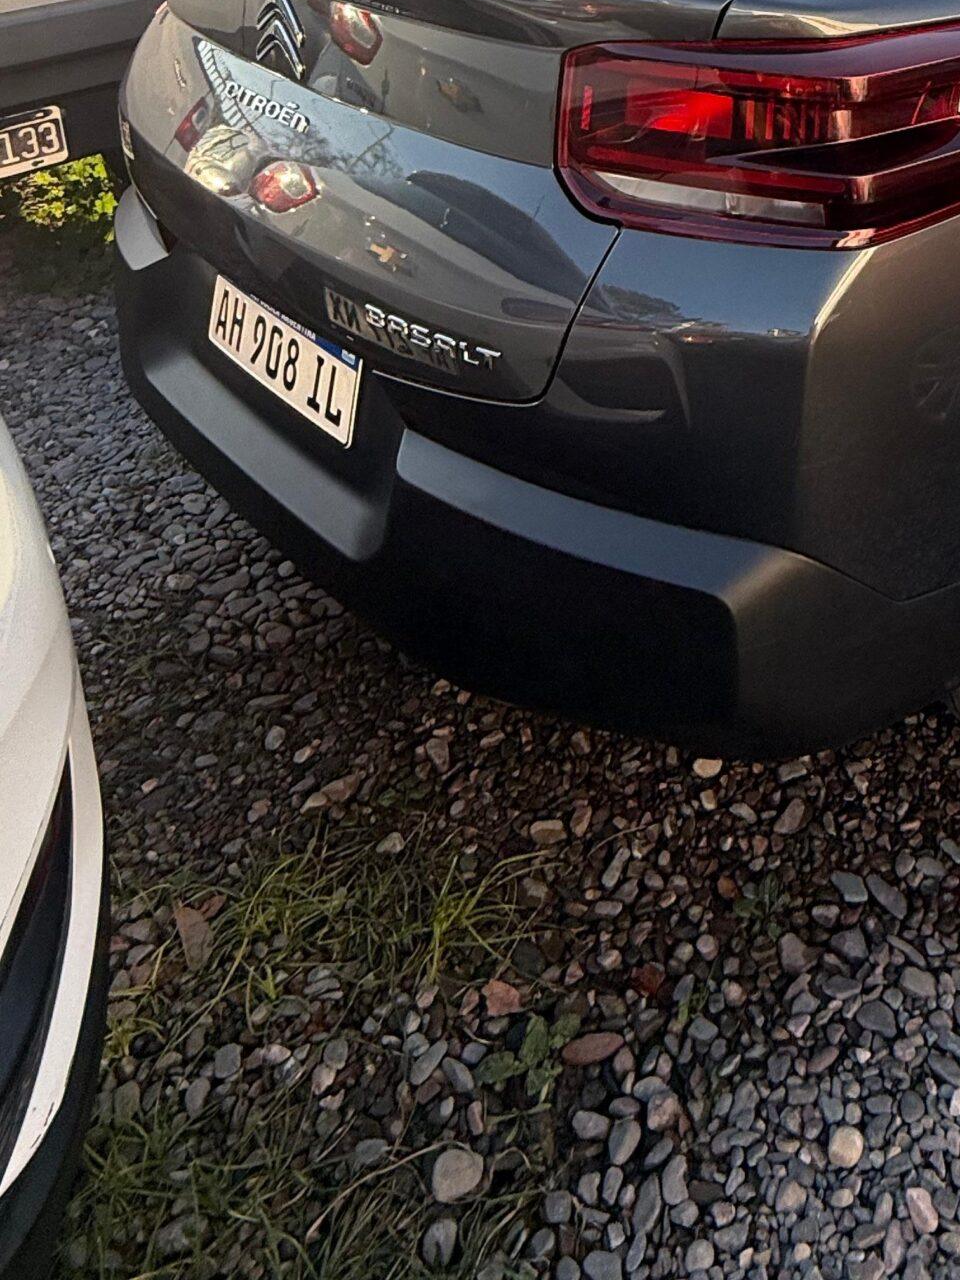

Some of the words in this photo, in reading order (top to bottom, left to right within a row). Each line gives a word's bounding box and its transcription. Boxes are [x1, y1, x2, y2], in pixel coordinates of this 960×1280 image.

[0, 121, 60, 165] 133
[215, 289, 247, 353] AH
[250, 314, 300, 392] 908
[307, 355, 341, 428] IL
[364, 303, 502, 370] BASALT
